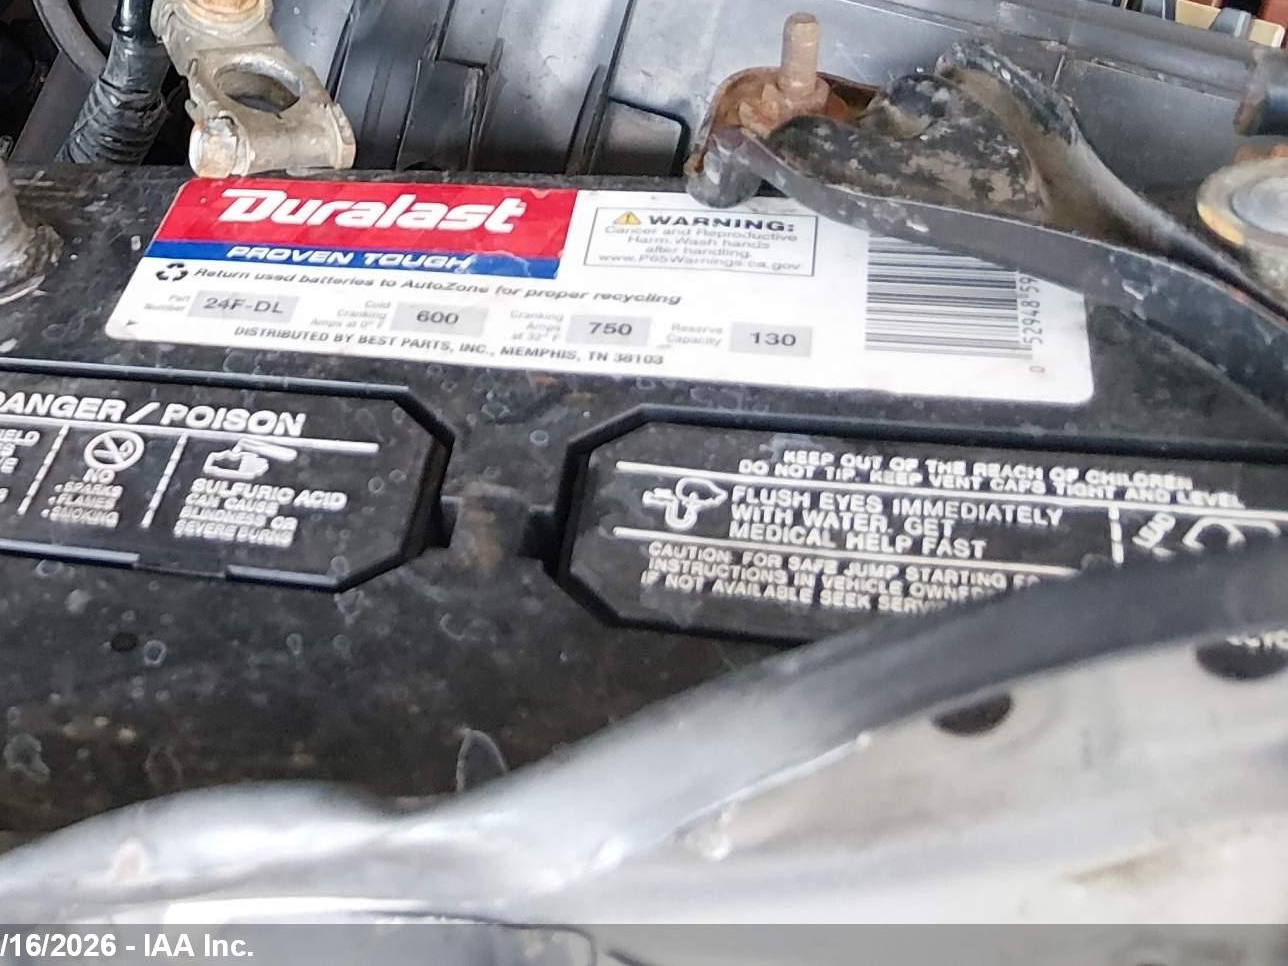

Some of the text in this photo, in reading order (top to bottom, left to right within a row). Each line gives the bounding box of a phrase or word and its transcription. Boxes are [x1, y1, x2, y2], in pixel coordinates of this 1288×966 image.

[218, 188, 527, 233] Duralast
[648, 215, 795, 232] WARNING:
[604, 225, 798, 242] Cancer and Reproductive
[675, 236, 718, 247] Wash
[722, 238, 770, 249] hands
[226, 245, 473, 269] PROVEN TOUGH
[645, 245, 679, 254] after
[194, 267, 682, 305] Return used batteries to AutoZone for proper recycling
[202, 297, 285, 315] 24F-DL
[416, 310, 460, 325] 600
[587, 321, 634, 337] 750
[750, 331, 798, 347] 130
[234, 325, 328, 342] DISTRIBUTED
[333, 332, 354, 343] BY
[357, 334, 399, 346] BEST
[400, 336, 455, 352] PARTS,
[500, 345, 580, 362] MEMPHIS,
[588, 350, 608, 362] TN
[613, 353, 665, 365] 38103
[127, 401, 161, 423] /
[161, 403, 307, 437] POISON
[82, 467, 115, 485] NO
[782, 449, 1194, 490] KEEP OUT OF THE REACH OF CHILDREN
[63, 481, 123, 498] SPARKS
[190, 477, 348, 511] SULFURIC ACID
[738, 458, 770, 476] DO
[774, 462, 816, 478] NOT
[869, 469, 924, 486] KEEP
[927, 473, 983, 491] VENT
[989, 478, 1047, 495] CAPS
[1052, 481, 1116, 500] TIGHT
[1124, 486, 1171, 503] AND
[1175, 489, 1247, 509] LEVEL
[56, 493, 117, 511] FLAMES
[185, 492, 280, 517] CAN CAUSE
[731, 485, 1063, 527] FLUSH EYES IMMEDIATELY
[49, 505, 120, 528] SMOKING
[178, 505, 299, 531] BLINDNESS OR
[730, 503, 956, 538] WITH WATER. GET
[173, 519, 295, 548] SEVERE BURNS
[728, 522, 987, 560] MEDICAL HELP FAST
[648, 557, 1000, 602] INSTRUCTIONS IN VEHICLE OWNER
[741, 551, 784, 569] FOR
[787, 555, 839, 575] SAFE
[843, 561, 900, 580] JUMP
[905, 565, 1007, 590] STARTING
[640, 569, 662, 586] IF
[664, 575, 705, 592] NOT
[712, 579, 814, 604] AVAILABLE
[819, 589, 872, 610] SEEK
